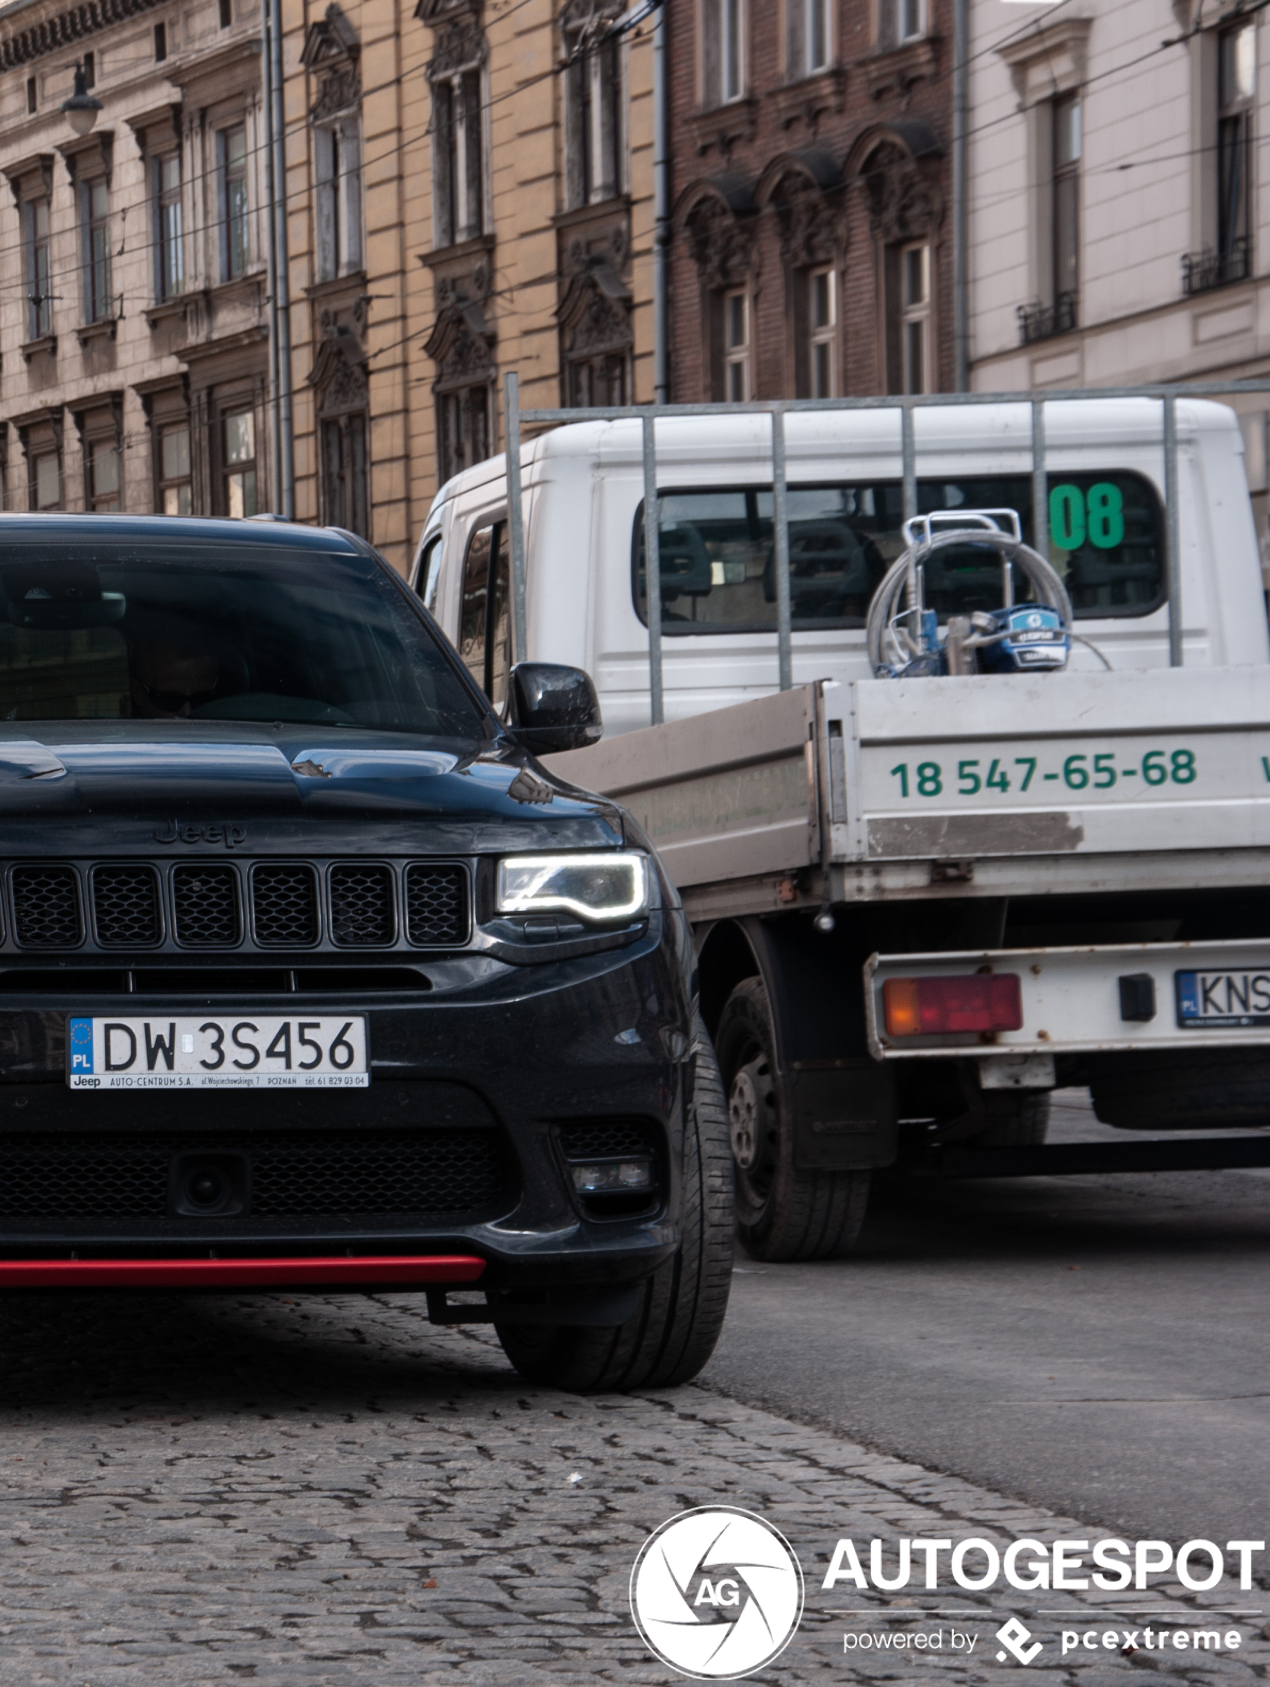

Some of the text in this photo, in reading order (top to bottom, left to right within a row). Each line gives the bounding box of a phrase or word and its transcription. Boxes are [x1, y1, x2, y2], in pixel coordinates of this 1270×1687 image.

[1049, 483, 1125, 551] 08
[890, 749, 1197, 798] 18 547-65-68
[154, 819, 247, 850] Jeep
[1182, 1001, 1198, 1013] PL
[1200, 975, 1270, 1014] KNS
[72, 1054, 91, 1068] PL
[104, 1021, 355, 1071] DW 3S456
[74, 1075, 101, 1088] Jeep
[110, 1077, 176, 1086] AUTO-CENTRUM
[178, 1077, 194, 1086] S.A.
[318, 1076, 326, 1085] 61
[329, 1076, 342, 1085] 829
[355, 1076, 365, 1085] 04
